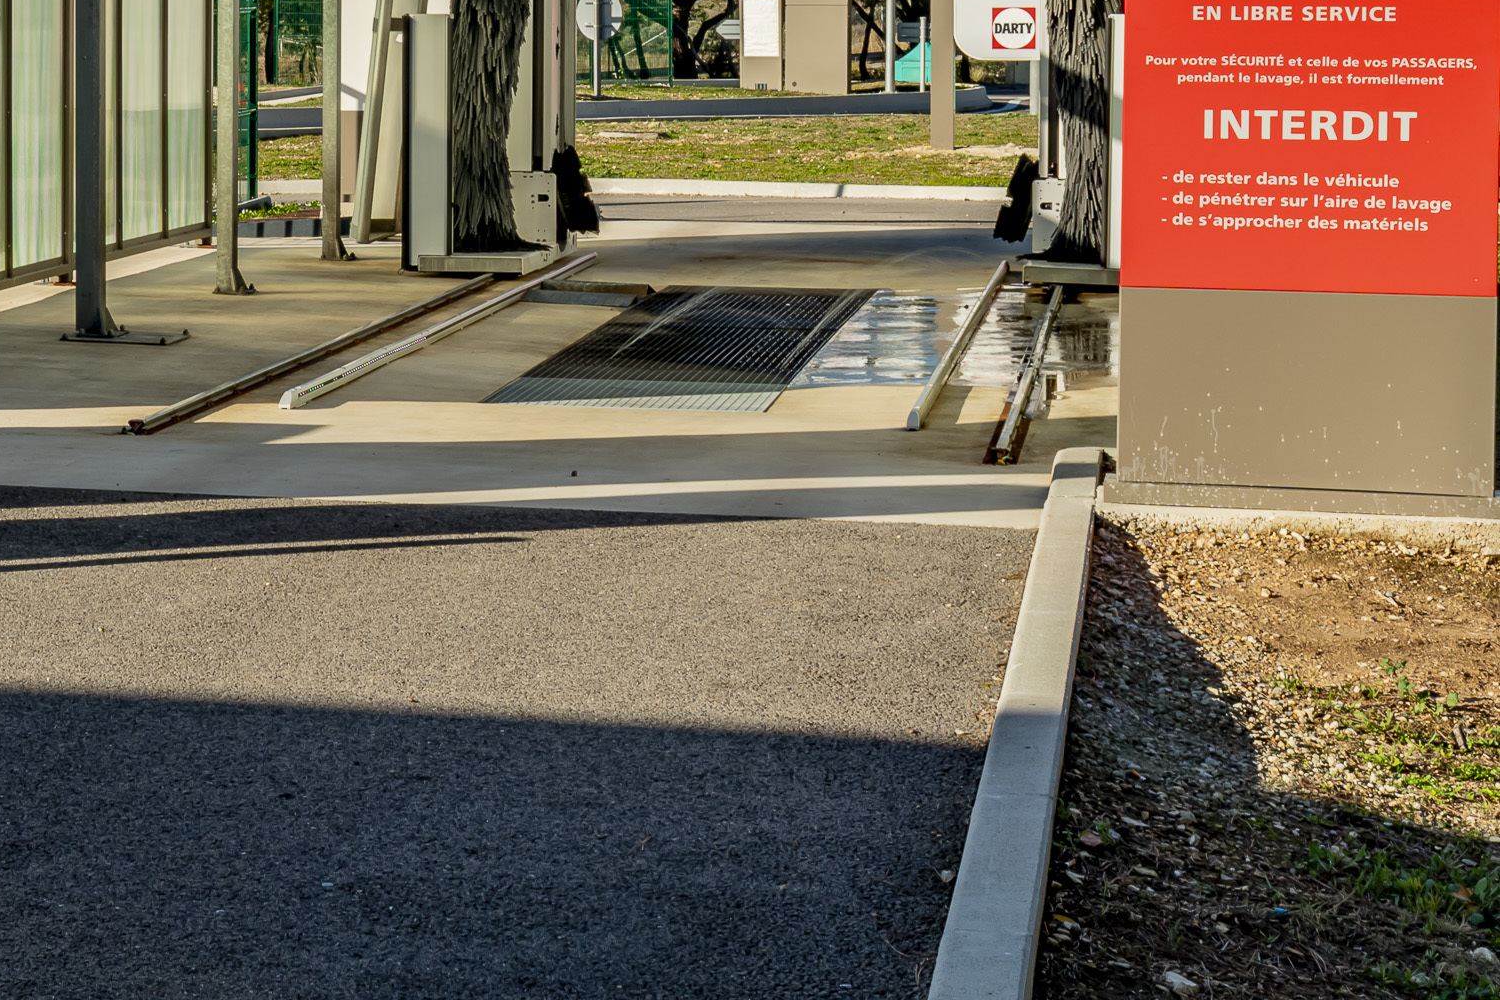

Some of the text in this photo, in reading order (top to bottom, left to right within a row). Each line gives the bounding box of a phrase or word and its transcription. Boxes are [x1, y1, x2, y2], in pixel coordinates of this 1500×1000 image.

[1193, 6, 1396, 21] EN LIBRE SERVICE
[995, 23, 1032, 34] DARTY
[1146, 55, 1177, 65] Pour
[1181, 56, 1217, 65] votre
[1222, 54, 1284, 66] SÉCURITÉ
[1288, 57, 1302, 66] et
[1307, 56, 1338, 67] celle
[1343, 57, 1359, 67] de
[1392, 58, 1477, 69] PASSAGERS,
[1178, 72, 1444, 86] pendant le lavage, il est formellement
[1204, 110, 1417, 141] INTERDIT
[1173, 170, 1194, 183] de
[1200, 172, 1251, 184] rester
[1256, 172, 1297, 185] dans
[1304, 173, 1319, 186] le
[1325, 174, 1399, 187] véhicule
[1173, 192, 1194, 204] de
[1200, 192, 1275, 208] pénétrer
[1281, 197, 1308, 207] sur
[1314, 194, 1358, 208] l'aire
[1364, 196, 1386, 208] de
[1393, 196, 1451, 213] lavage
[1172, 212, 1193, 225] de
[1199, 214, 1302, 230] s'approcher
[1308, 216, 1338, 229] des
[1344, 218, 1428, 231] matériels
